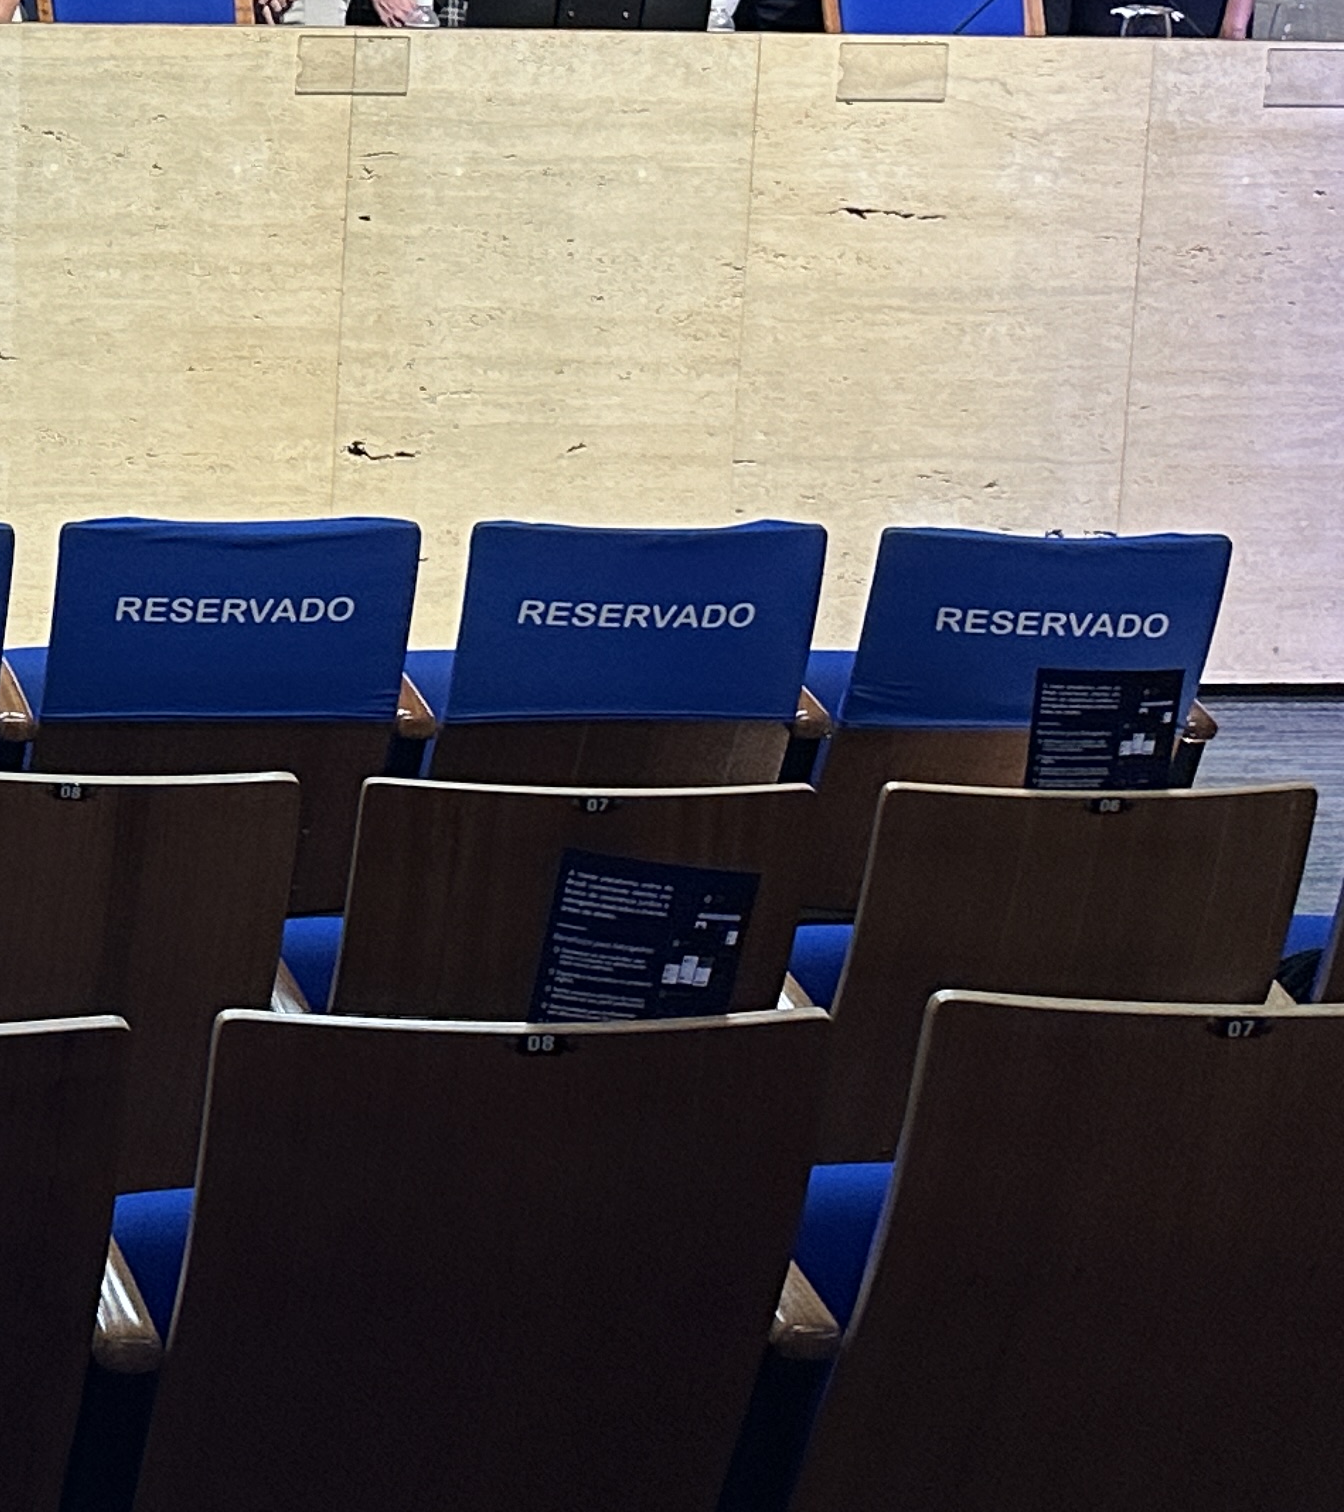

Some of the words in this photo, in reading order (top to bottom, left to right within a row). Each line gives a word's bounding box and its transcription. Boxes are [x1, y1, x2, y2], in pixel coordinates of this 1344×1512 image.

[116, 597, 354, 623] RESERVADO
[518, 600, 755, 627] RESERVADO
[937, 608, 1168, 637] RESERVADO
[60, 786, 81, 800] 08
[586, 798, 608, 812] 07
[1227, 1020, 1255, 1038] 07
[527, 1035, 555, 1052] 08
